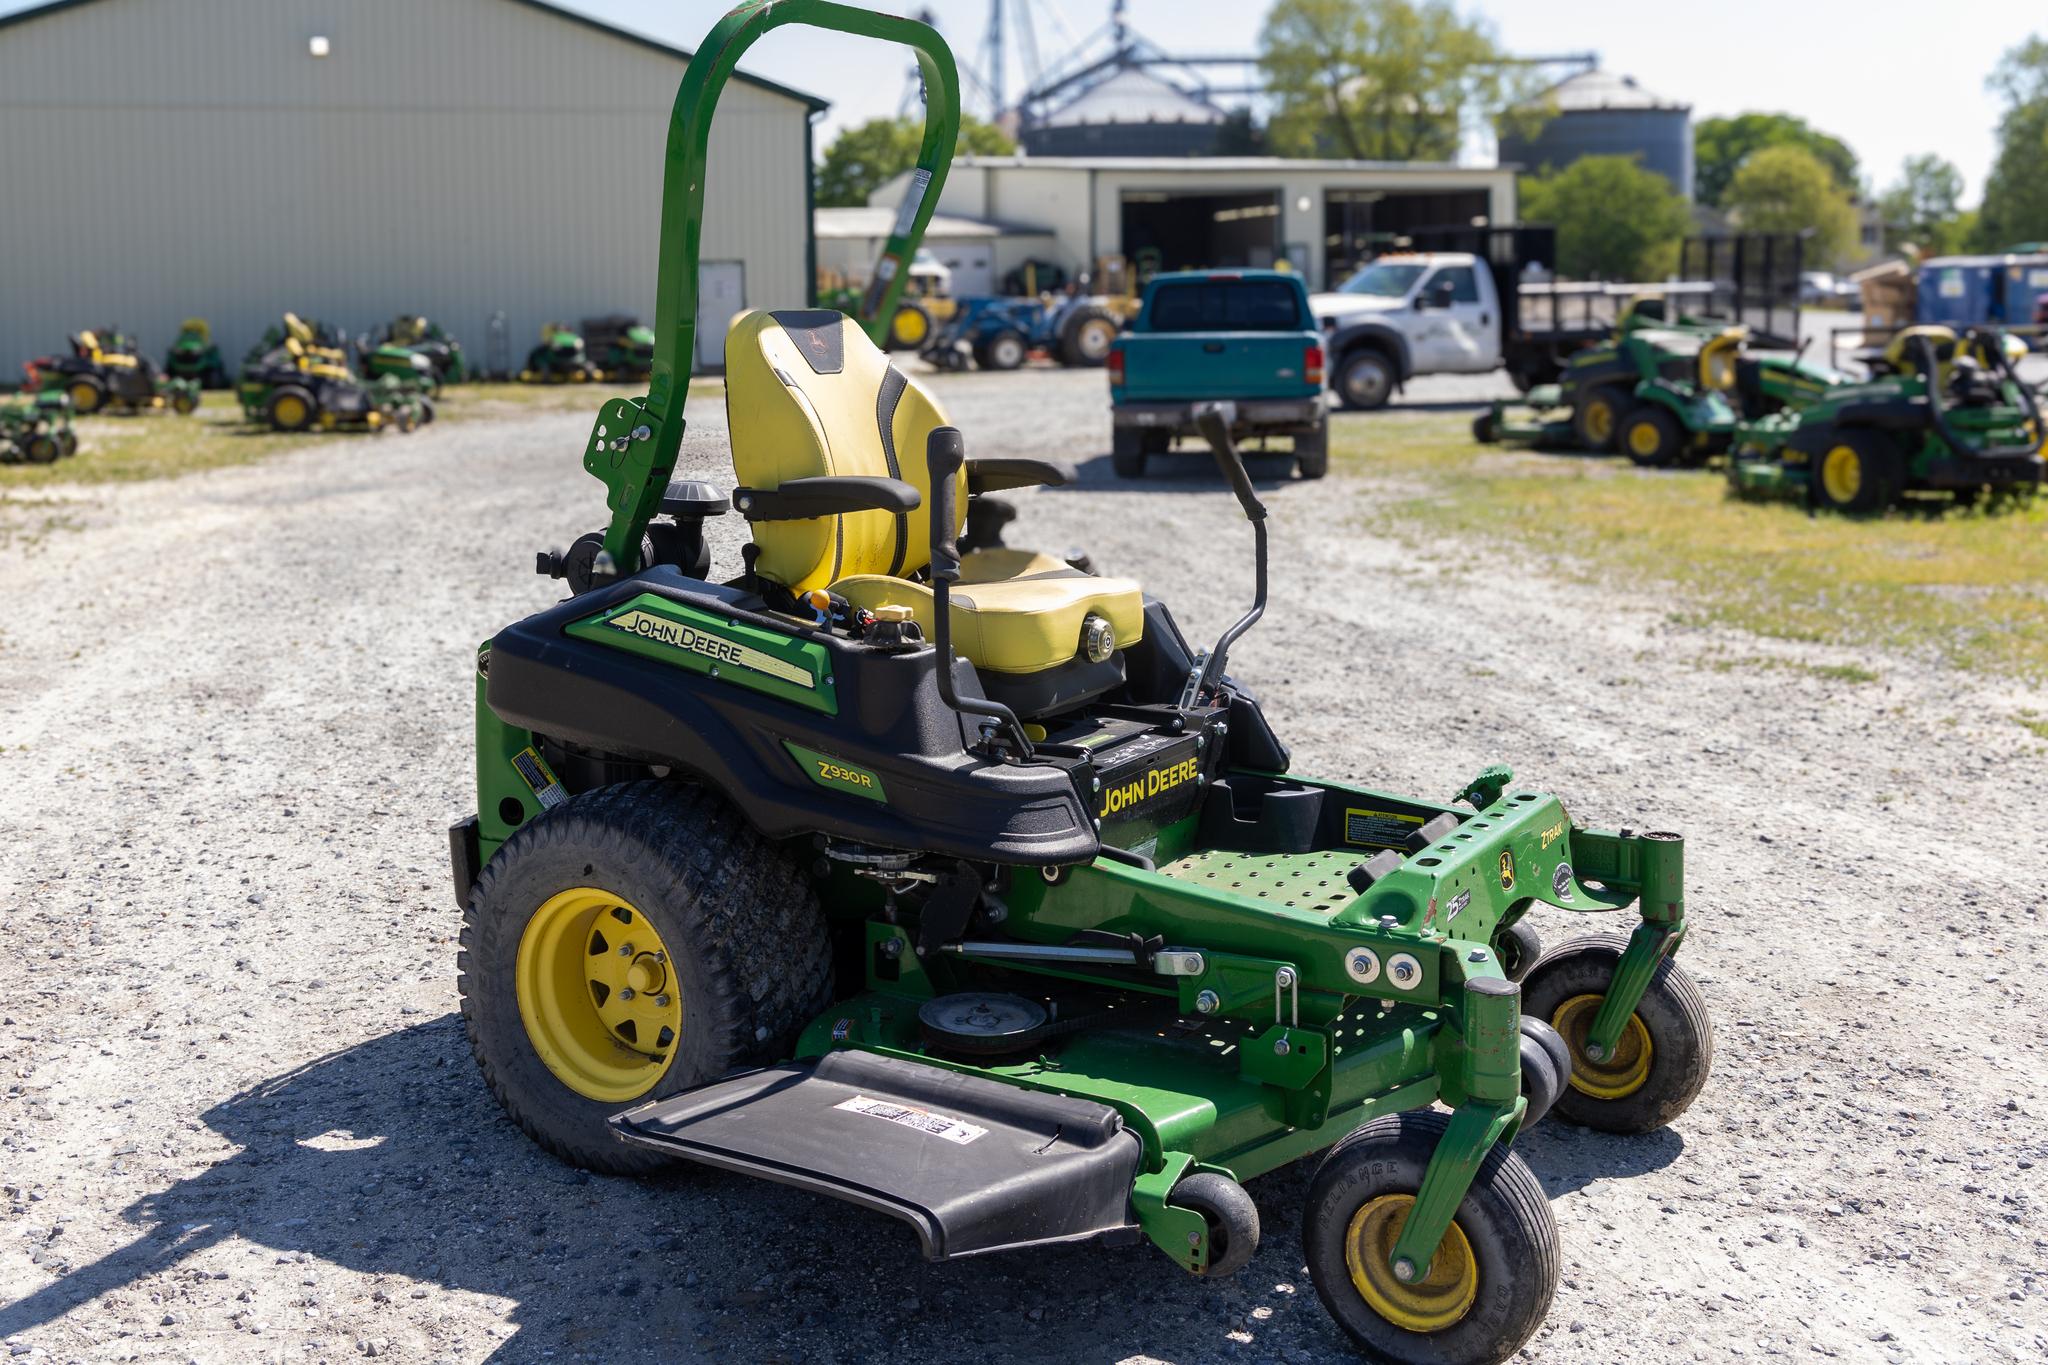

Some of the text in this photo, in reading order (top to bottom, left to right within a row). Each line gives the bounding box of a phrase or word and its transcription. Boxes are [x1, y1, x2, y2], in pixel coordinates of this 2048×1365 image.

[627, 614, 743, 663] JOHN DEERE
[817, 759, 873, 789] Z930R
[1100, 757, 1197, 817] JOHN DEERE
[1540, 821, 1563, 851] ZTRAK
[479, 904, 507, 1023] KENDA
[1318, 1160, 1399, 1229] RELIANCE
[1464, 1197, 1479, 1213] RIB
[1440, 1284, 1508, 1363] CARLISLE
